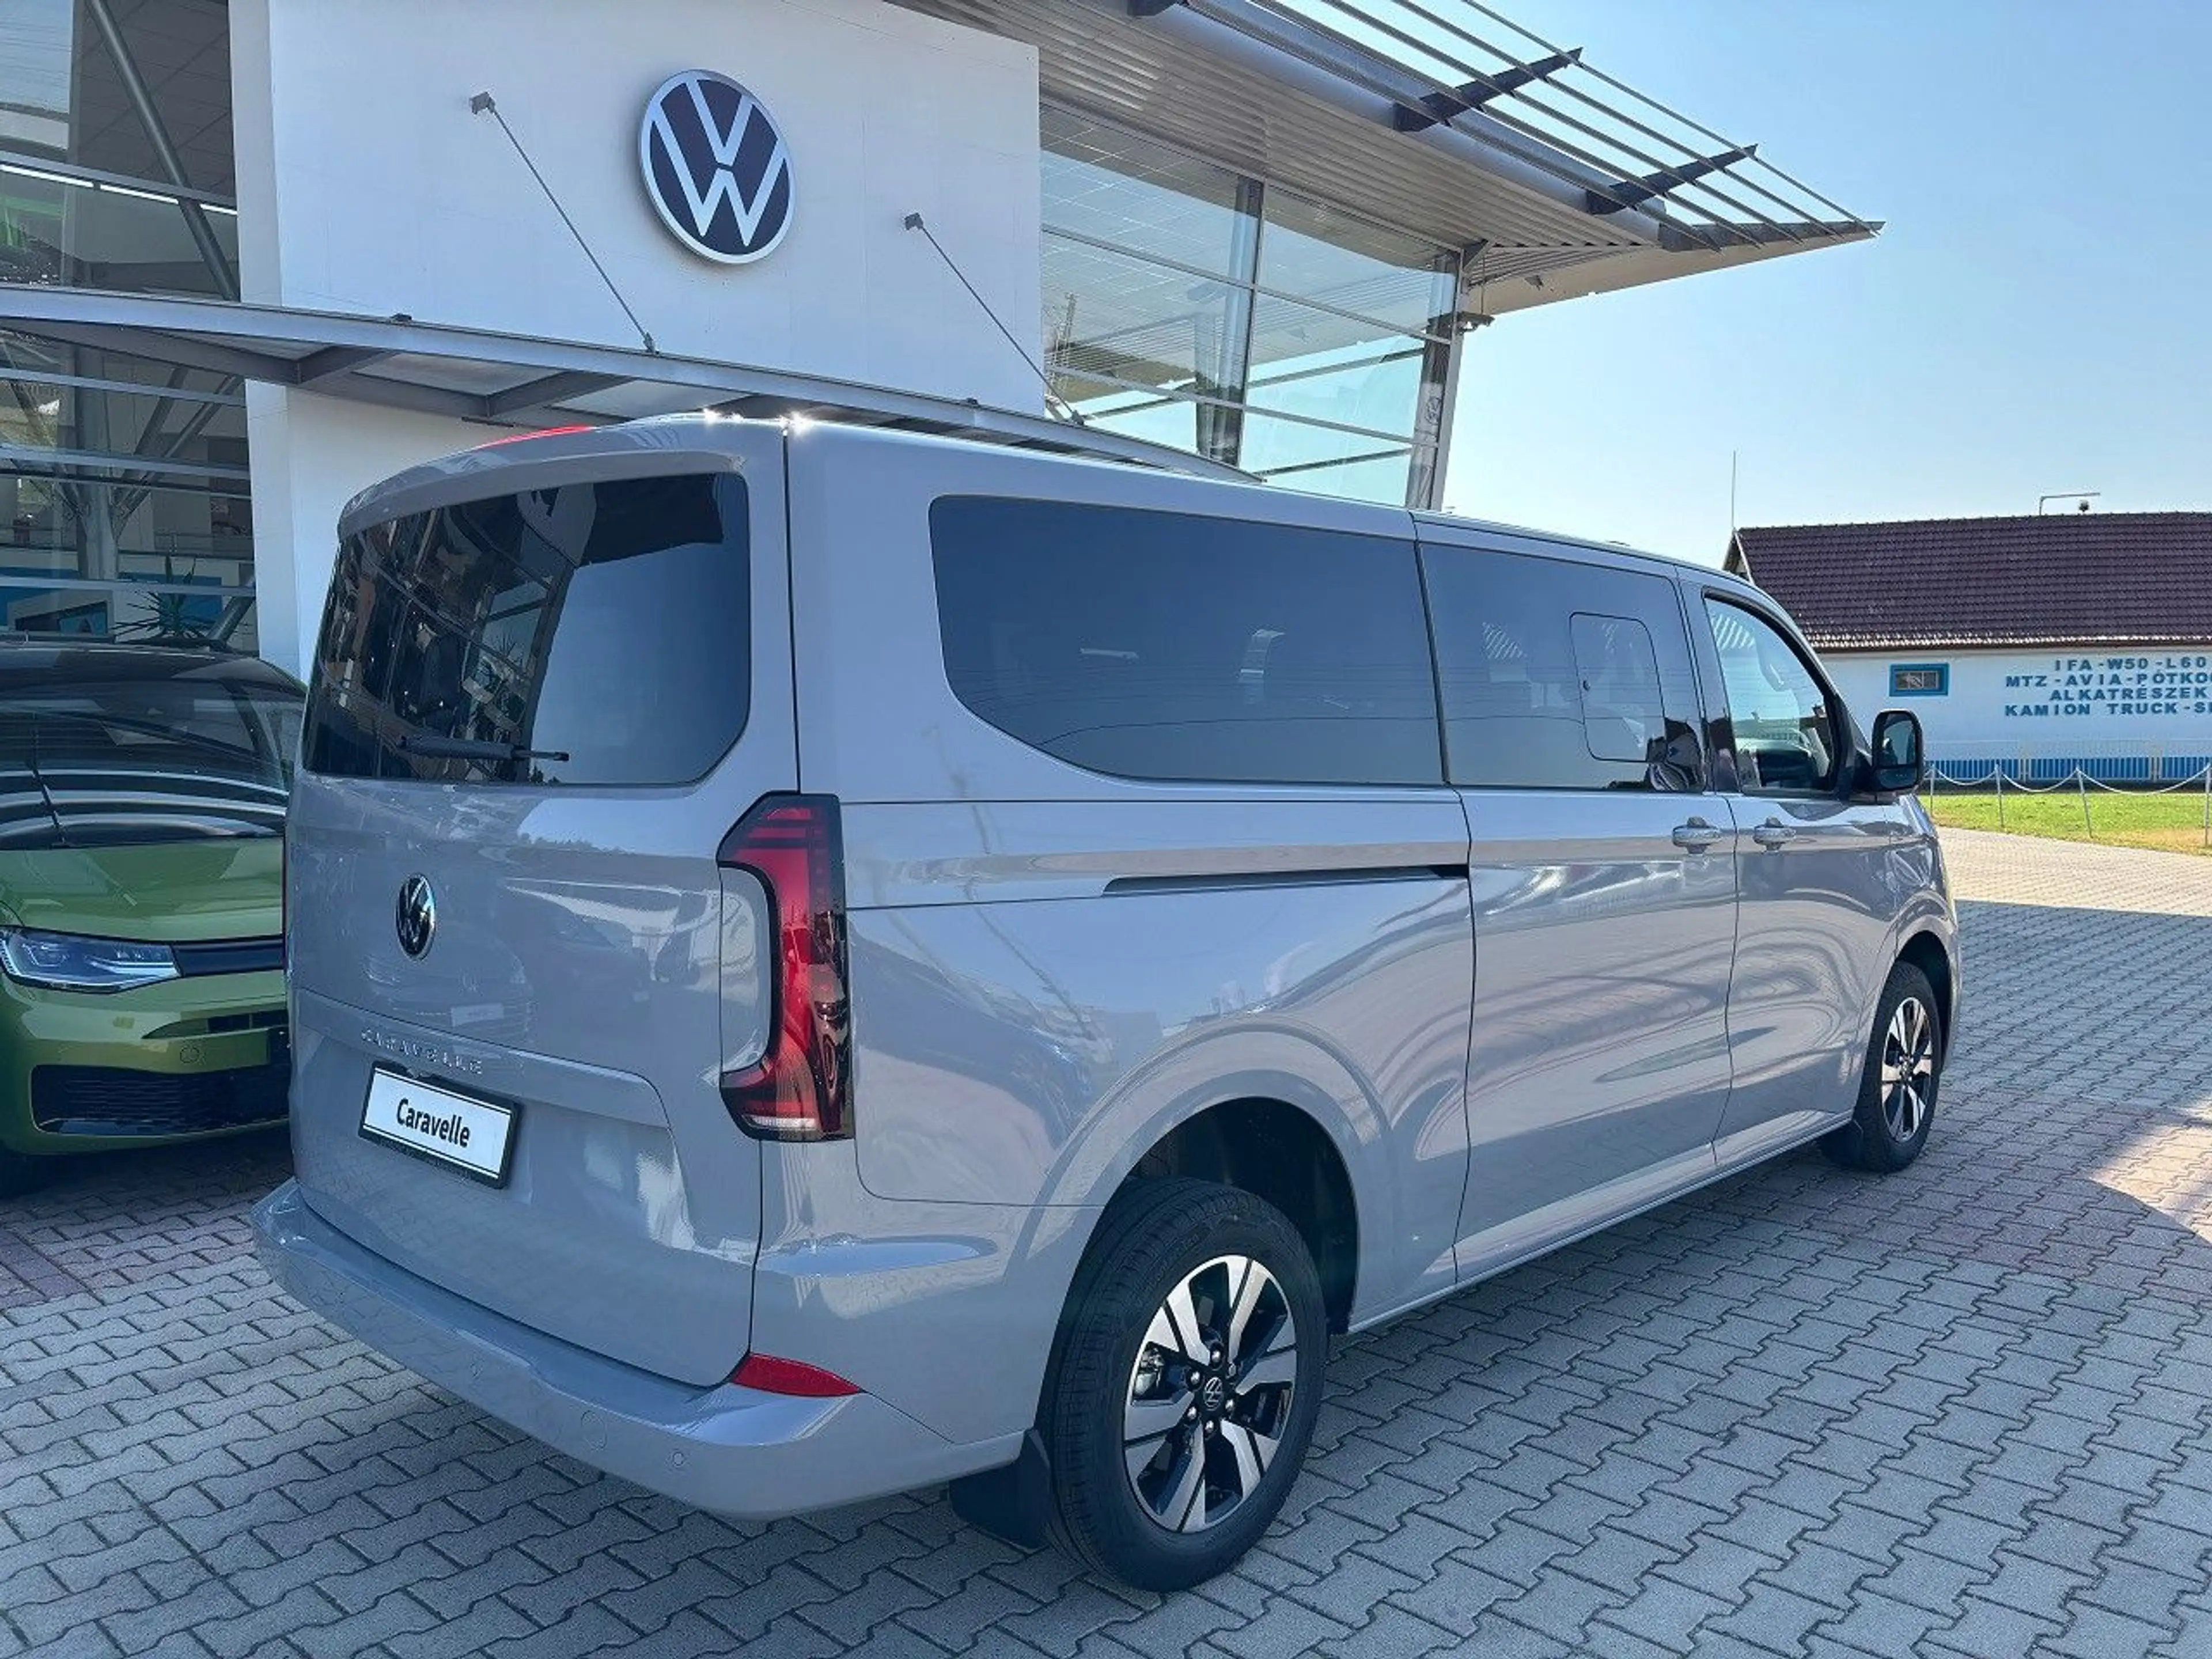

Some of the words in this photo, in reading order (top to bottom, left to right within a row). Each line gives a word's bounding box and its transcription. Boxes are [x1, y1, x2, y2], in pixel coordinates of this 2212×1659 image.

[643, 70, 795, 262] VW
[2006, 669, 2212, 687] MTZ-AVIA-PÓTKO
[2049, 684, 2207, 700] ALKATRÉSZEK
[2005, 703, 2090, 716] KAMION
[397, 1097, 471, 1148] Caravelle
